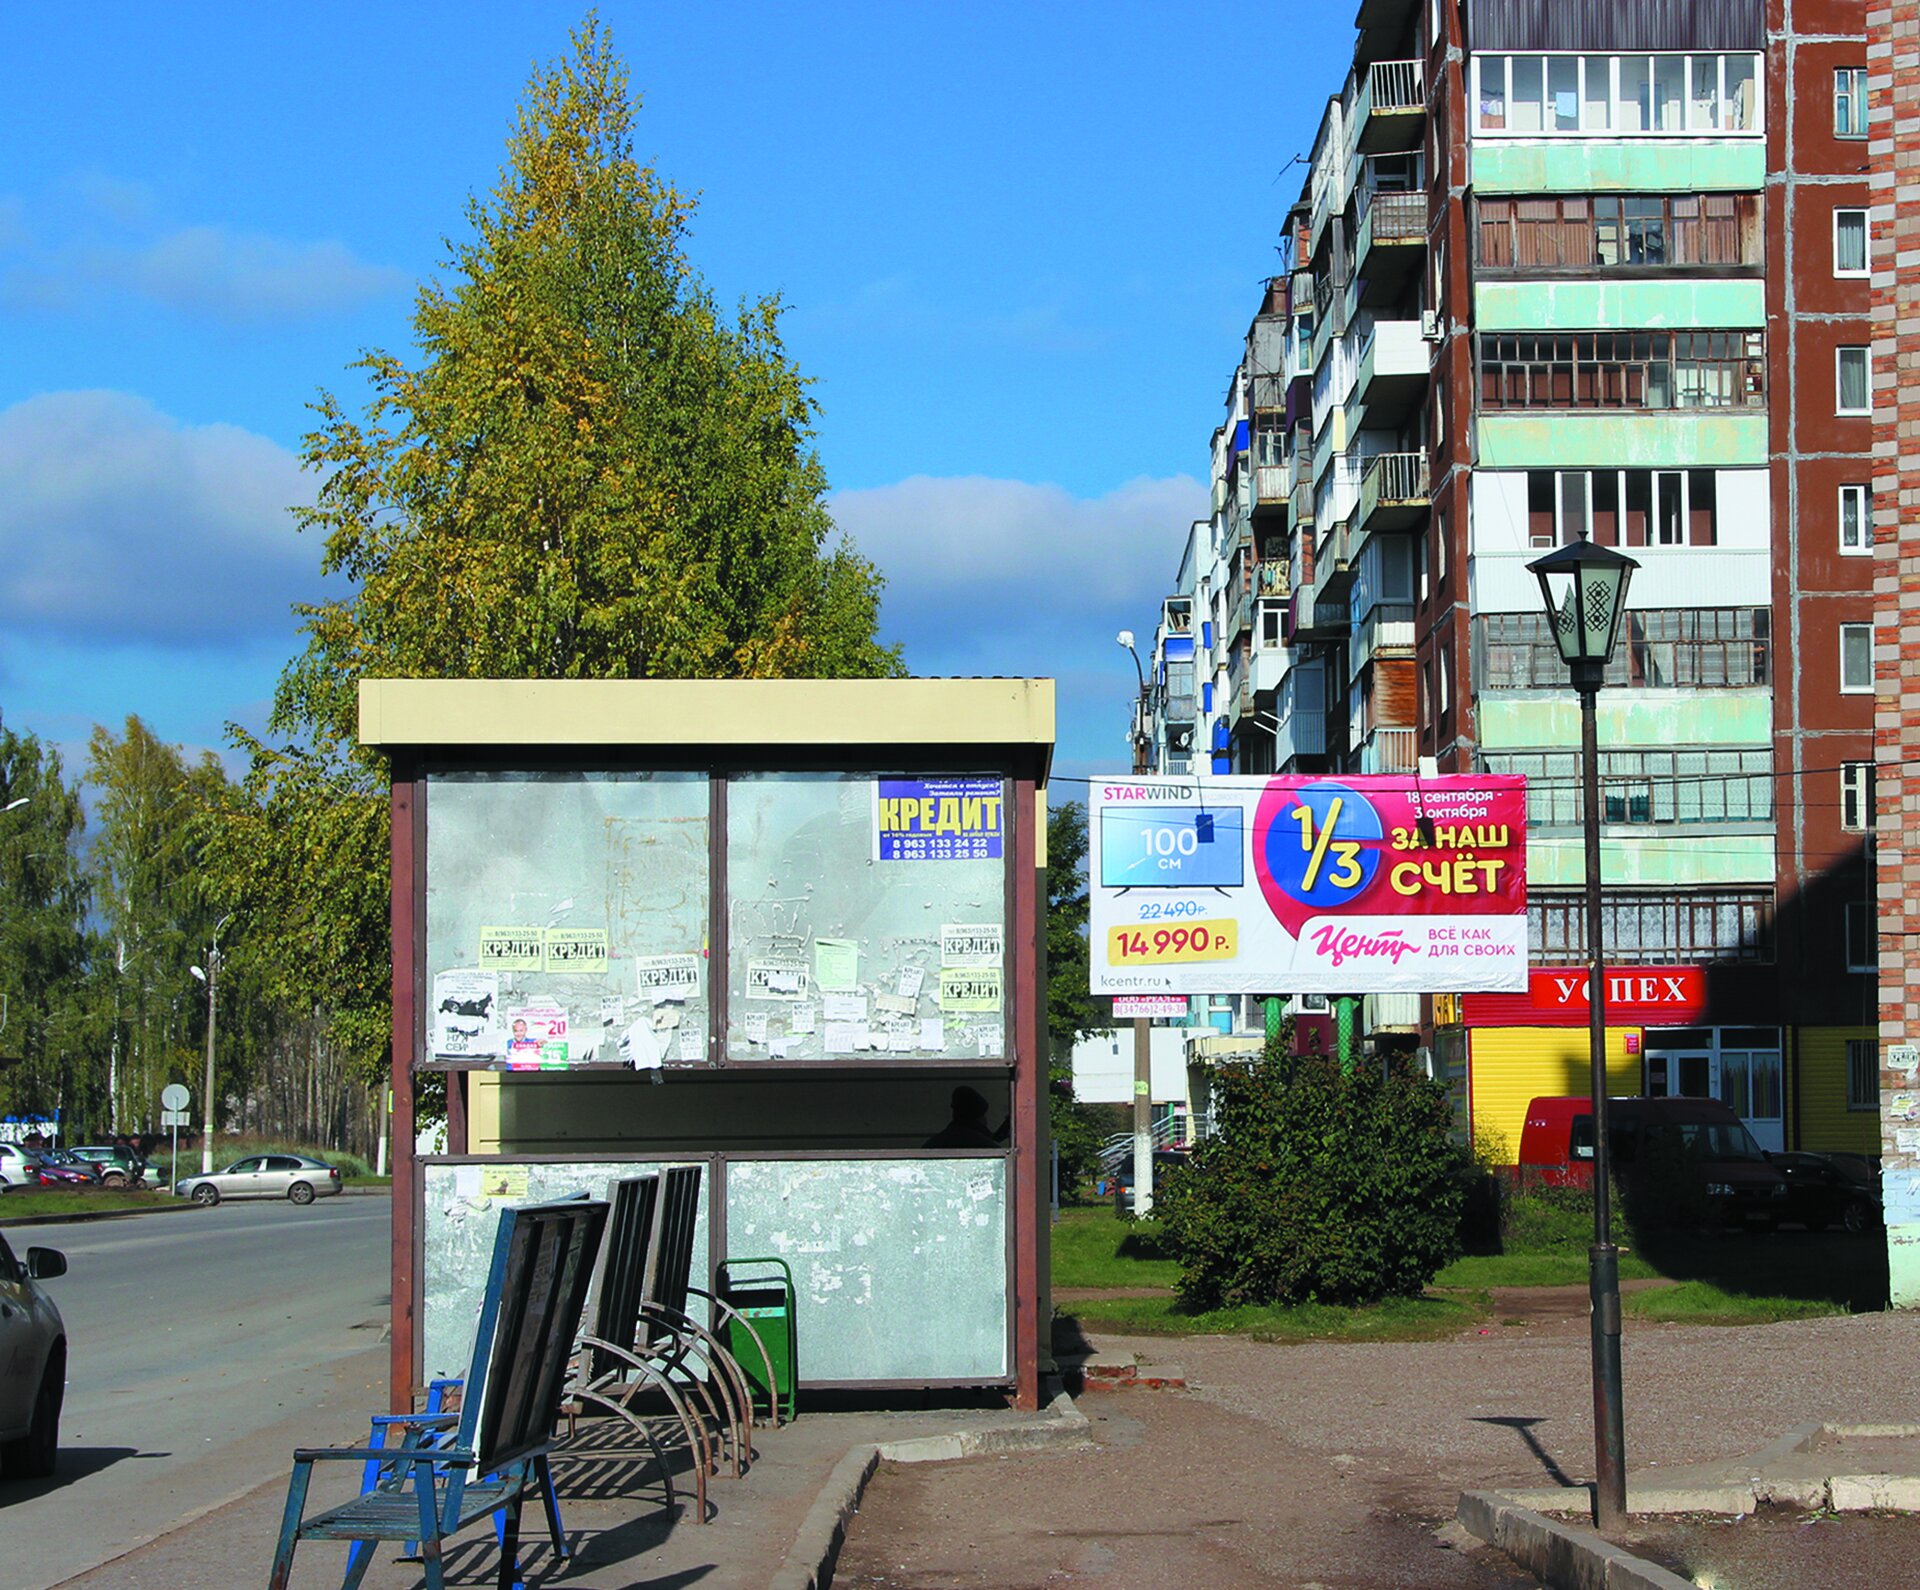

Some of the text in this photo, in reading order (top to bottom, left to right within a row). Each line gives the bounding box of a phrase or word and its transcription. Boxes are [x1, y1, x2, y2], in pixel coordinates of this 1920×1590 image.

[1104, 787, 1193, 800] STARWIND
[1405, 791, 1420, 804] 18
[1424, 788, 1494, 804] сентября
[880, 798, 1001, 836] КРЕДИТ
[1414, 804, 1488, 820] 3 октября
[893, 838, 987, 848] 8 963 133 24 22
[1140, 828, 1198, 856] 100
[1291, 797, 1363, 892] 1/3
[1391, 824, 1509, 850] ЗА НАШ
[893, 849, 988, 859] 8 963 133 25 50
[1390, 853, 1505, 896] СЧЁТ
[1428, 925, 1491, 940] ВСЁ КАК
[482, 941, 540, 957] КРЕДИТ
[549, 943, 605, 960] КРЕДИТ
[945, 938, 1000, 954] КРЕДИТ
[1310, 924, 1422, 967] Центр
[1428, 943, 1516, 958] ДЛЯ СВОИХ
[640, 967, 697, 987] КРЕДИТ
[1101, 975, 1161, 987] kcentr.ru
[943, 982, 999, 998] КРЕДИТ
